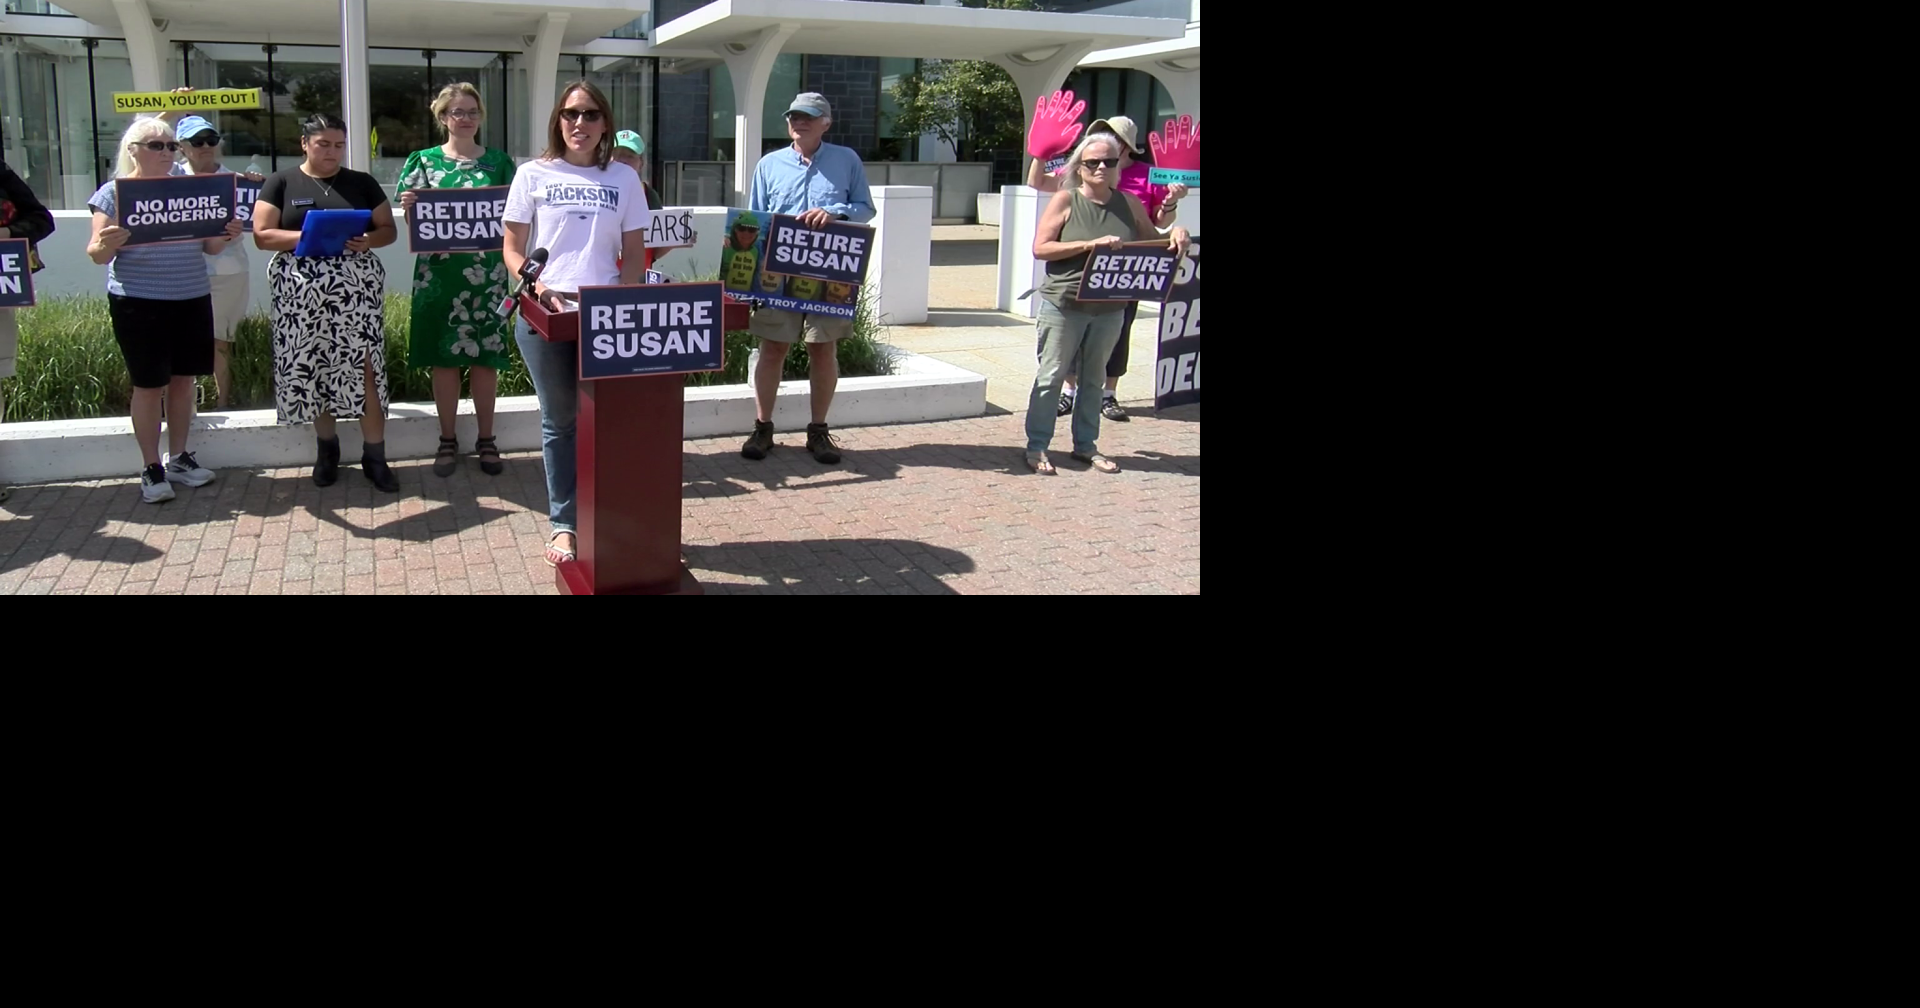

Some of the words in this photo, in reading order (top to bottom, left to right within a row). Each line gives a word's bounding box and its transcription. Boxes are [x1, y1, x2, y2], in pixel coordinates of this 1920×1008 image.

[117, 97, 166, 108] SUSAN,
[169, 95, 217, 106] YOU'RE
[220, 93, 248, 104] OUT
[135, 200, 164, 213] NO
[168, 195, 220, 211] MORE
[545, 187, 619, 207] JACKSON
[127, 207, 228, 226] CONCERNS
[416, 200, 506, 220] RETIRE
[777, 226, 865, 255] RETIRE
[775, 245, 860, 272] SUSAN
[1092, 255, 1174, 274] RETIRE
[1088, 272, 1166, 291] SUSAN
[591, 300, 713, 331] RETIRE
[768, 297, 797, 309] TROY
[800, 302, 854, 317] JACKSON
[592, 328, 711, 360] SUSAN
